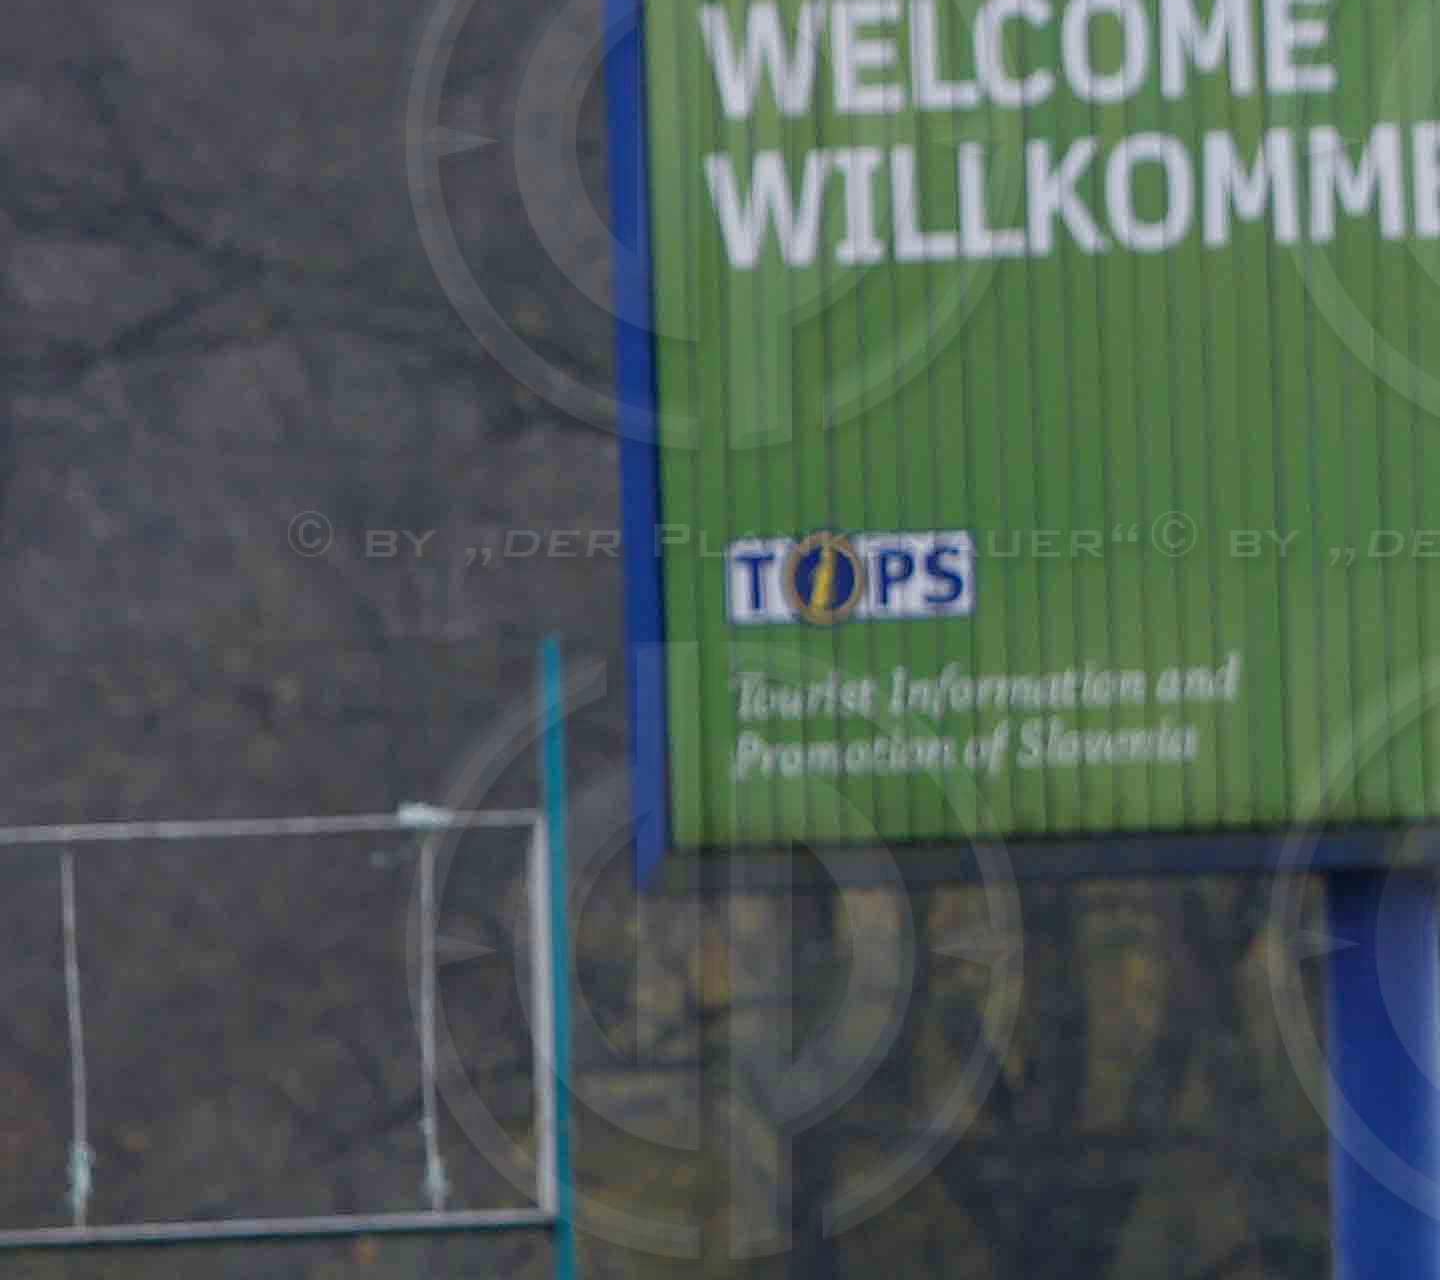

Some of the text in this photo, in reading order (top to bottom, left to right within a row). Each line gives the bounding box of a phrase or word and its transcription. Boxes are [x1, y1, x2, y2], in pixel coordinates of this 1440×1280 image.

[732, 651, 1240, 721] Tourist Information and
[733, 717, 1198, 782] Promotion of Slovenia
